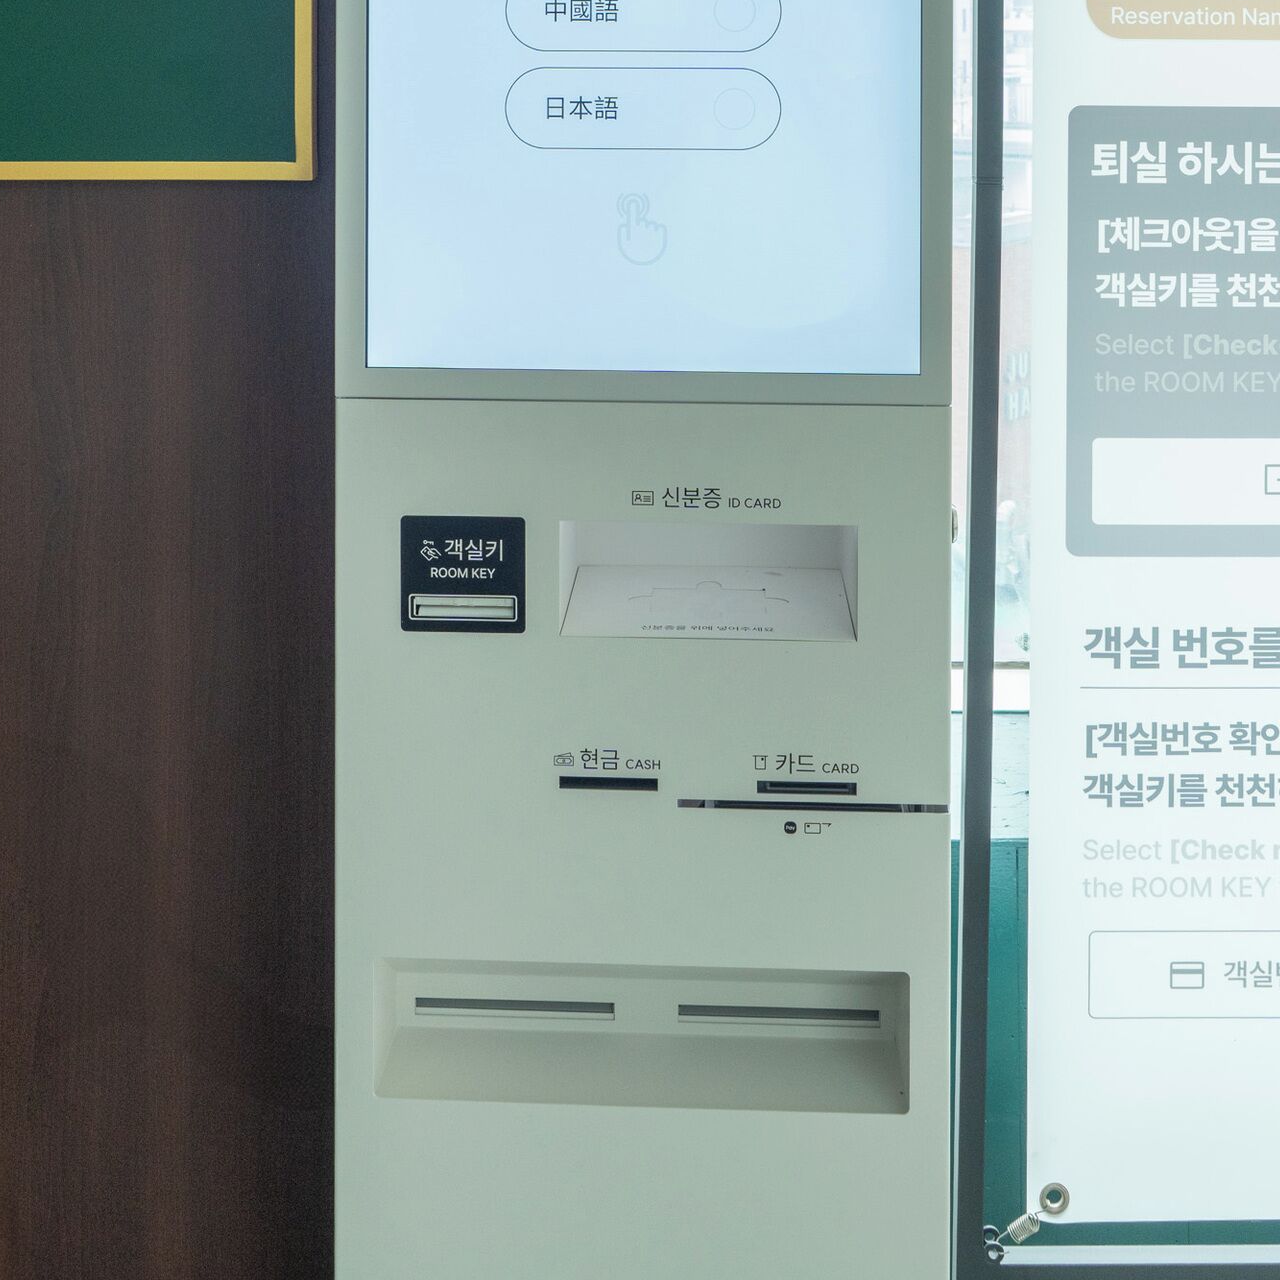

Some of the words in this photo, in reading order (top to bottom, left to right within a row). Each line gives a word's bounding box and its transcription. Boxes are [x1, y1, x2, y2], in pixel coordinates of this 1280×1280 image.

[1112, 7, 1235, 25] Reservation
[547, 96, 618, 120] 日本語
[1091, 141, 1167, 183] 퇴실
[1098, 217, 1279, 254] [체크아웃]을
[1095, 273, 1220, 307] 객실키를
[1096, 334, 1174, 355] Select
[1095, 371, 1135, 392] the
[1145, 371, 1224, 392] ROOM
[662, 487, 721, 508] 신분증
[729, 498, 740, 508] ID
[744, 498, 781, 508] CARD
[445, 539, 502, 561] 객실키
[431, 567, 468, 578] ROOM
[472, 568, 495, 578] KEY
[1084, 627, 1159, 669] 객실
[1086, 722, 1222, 758] [객실번호
[580, 749, 619, 770] 현금
[626, 759, 660, 770] CASH
[776, 753, 815, 774] 카드
[822, 763, 859, 773] CARD
